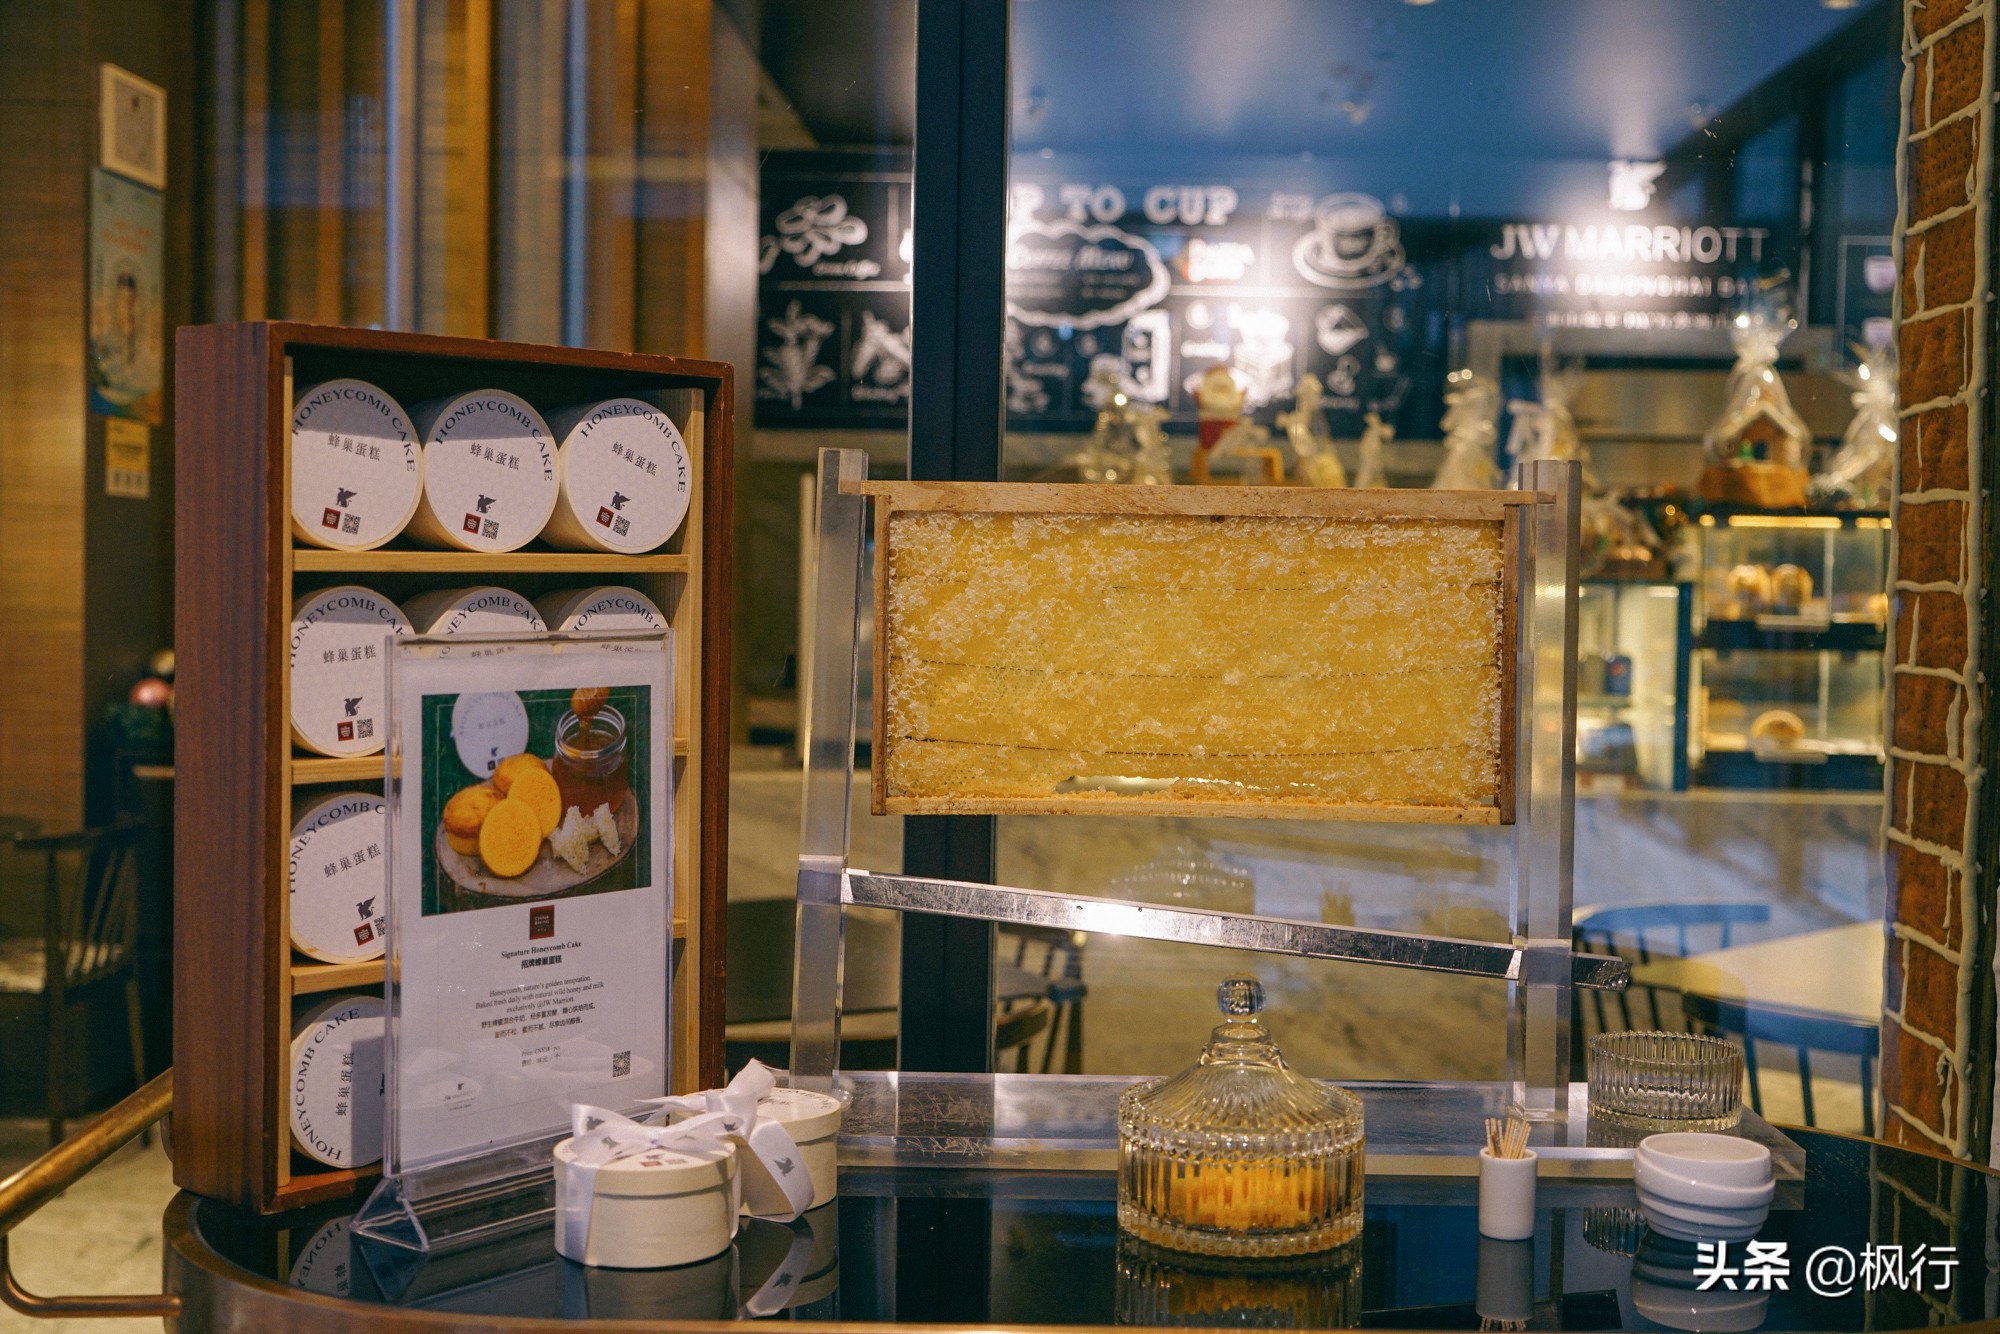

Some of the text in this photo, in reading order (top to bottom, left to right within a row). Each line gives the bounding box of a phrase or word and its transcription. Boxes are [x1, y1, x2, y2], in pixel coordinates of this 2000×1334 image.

[1059, 183, 1126, 223] TO
[1143, 185, 1238, 225] CUP
[1490, 224, 1770, 264] JW MARRIOTT
[291, 388, 416, 473] HONEYCOMB CAKE
[327, 432, 381, 461] 蜂巢蛋糕
[435, 400, 553, 482] HONEYCOMB CAKE
[580, 404, 686, 493] HONEYCOMB CAKE
[469, 441, 520, 470] 蜂巢蛋糕
[611, 441, 658, 476] 蜂巢蛋糕
[323, 644, 377, 664] 蜂巢蛋糕
[324, 842, 382, 878] 蜂巢蛋糕
[501, 940, 582, 959] Signature Honeycomb Cake
[475, 1000, 493, 1009] Baked
[508, 996, 521, 1005] daily
[522, 993, 534, 1001] with
[554, 988, 566, 996] wild
[566, 986, 582, 995] honey
[582, 983, 593, 991] and
[593, 981, 605, 989] milk
[546, 980, 563, 990] golden
[295, 1008, 361, 1161] HONEYCOMB CAKE
[336, 1052, 354, 1117] 蜂巢蛋糕
